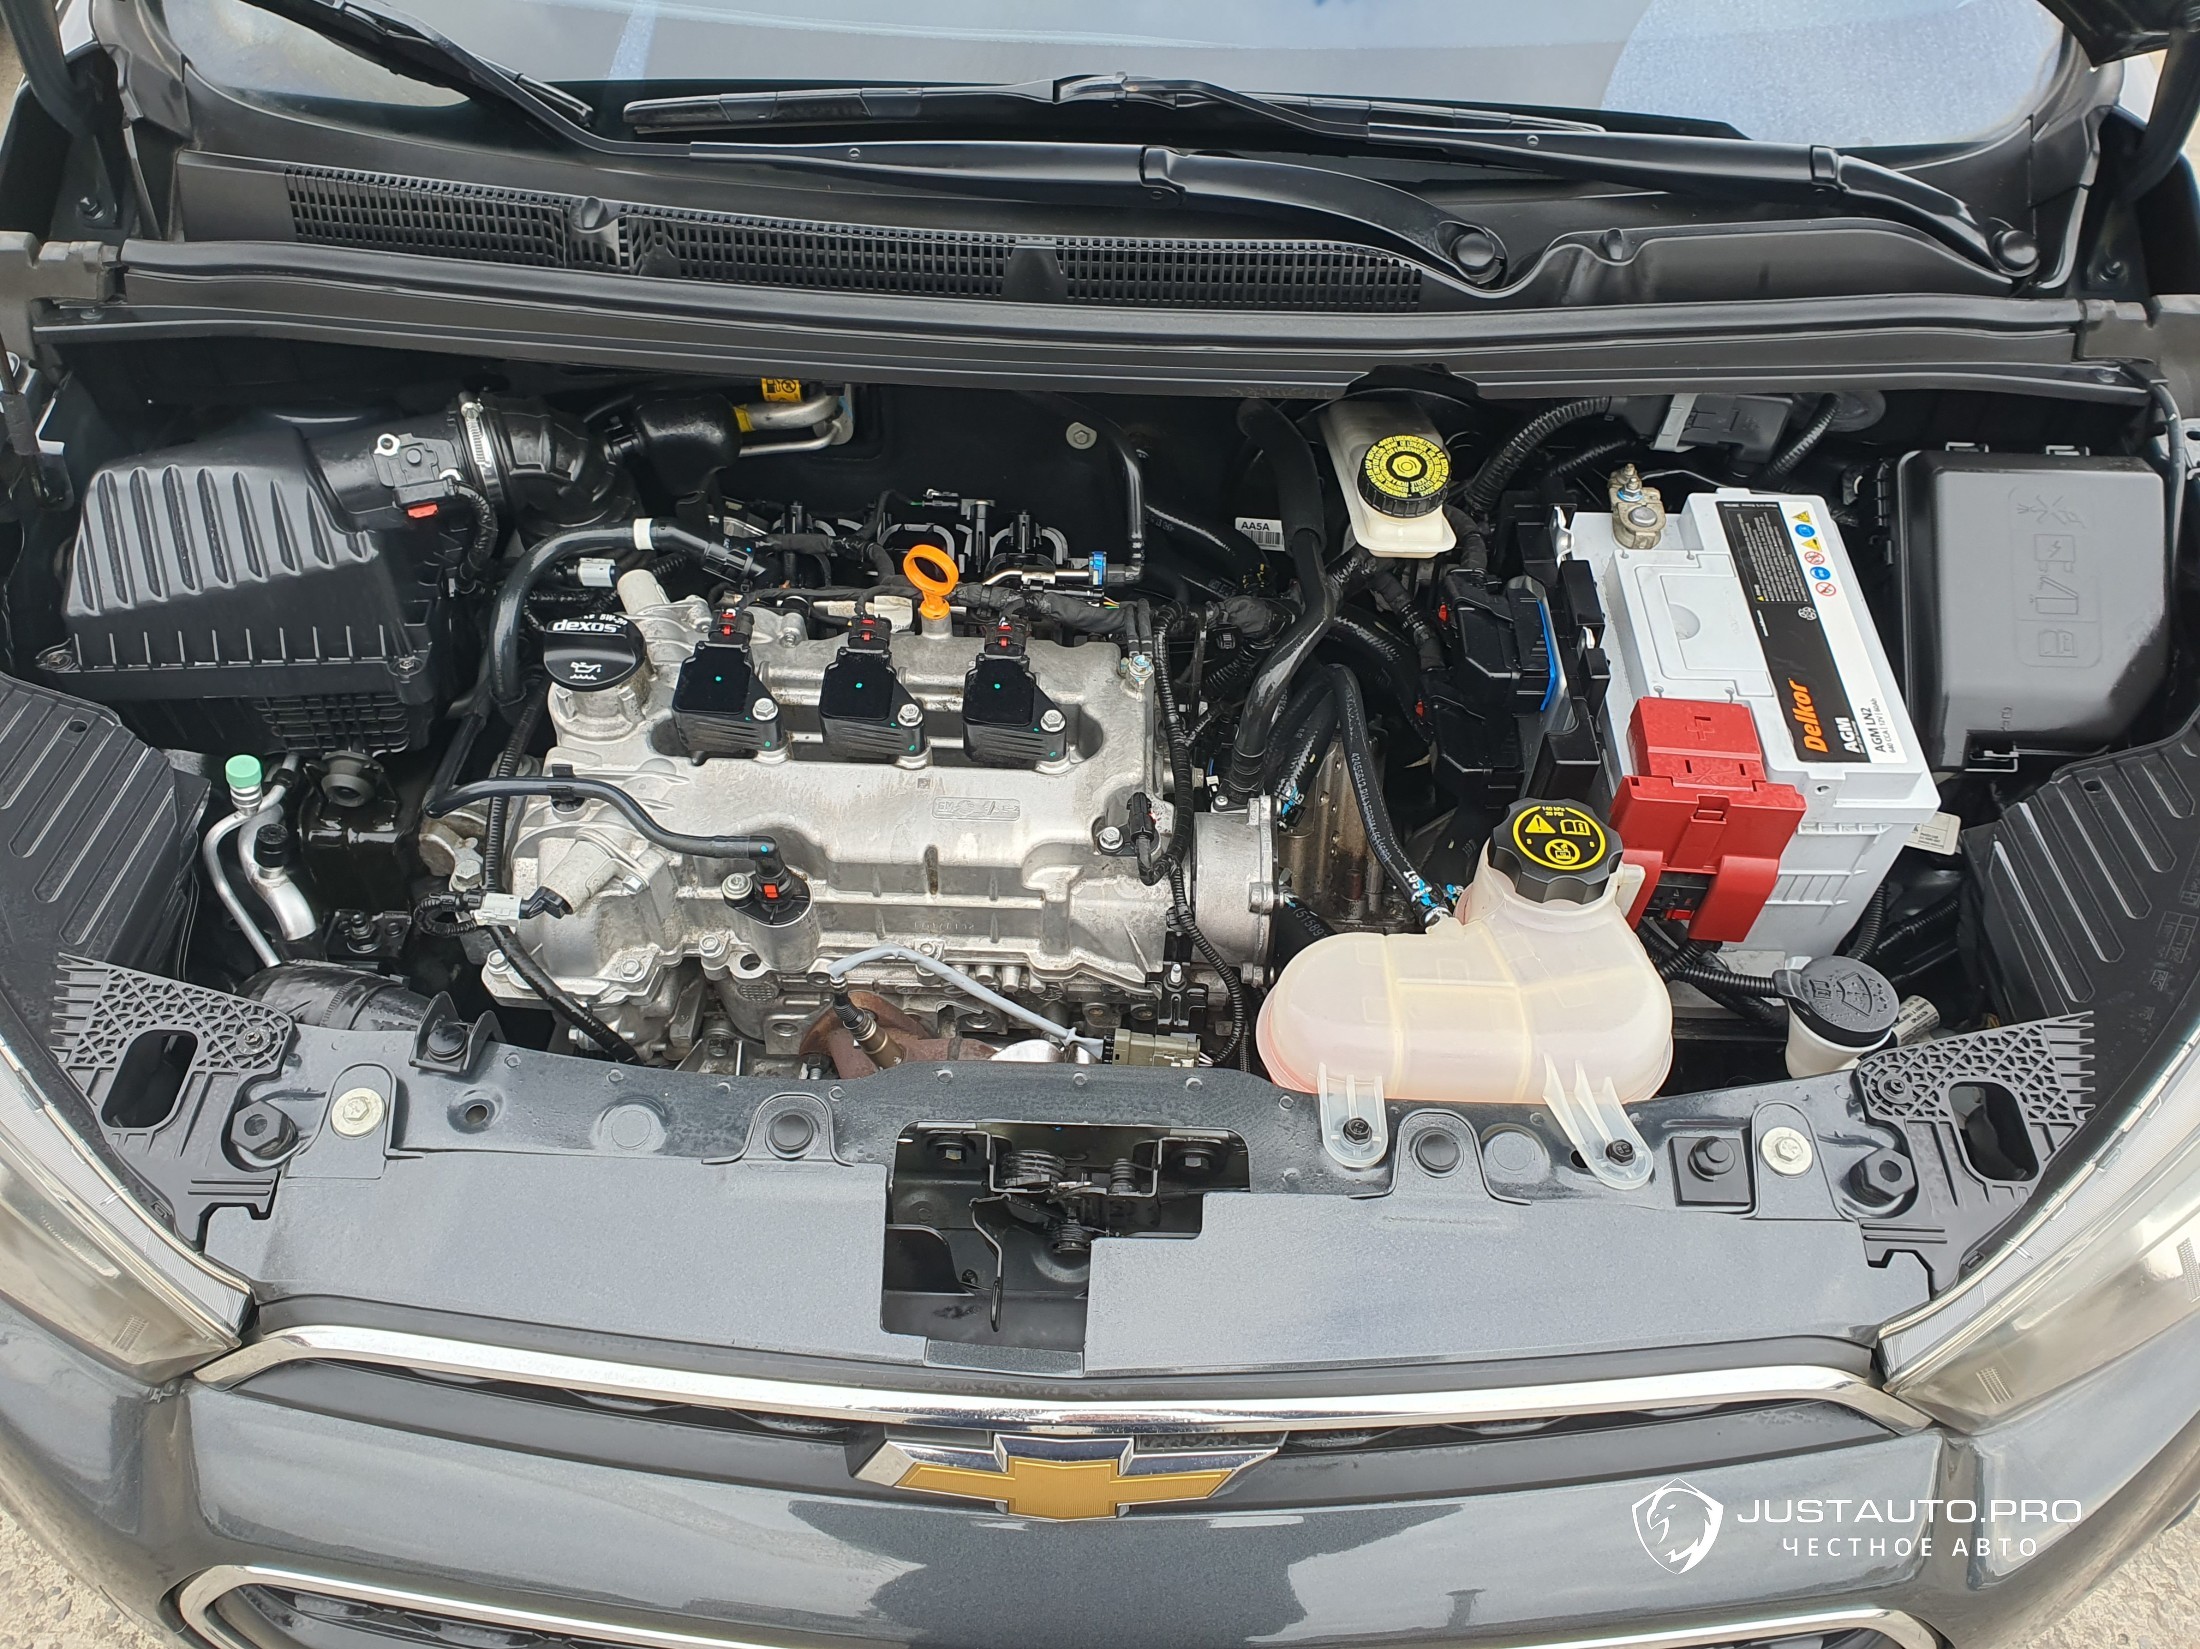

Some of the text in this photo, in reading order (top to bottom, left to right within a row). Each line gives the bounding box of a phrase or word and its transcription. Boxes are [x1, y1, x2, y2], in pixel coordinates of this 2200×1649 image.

[1241, 521, 1270, 531] AA5A
[552, 619, 622, 633] dexos
[1789, 678, 1829, 753] Delkor
[1860, 707, 1886, 753] AGM LN2
[1834, 717, 1861, 754] AGM
